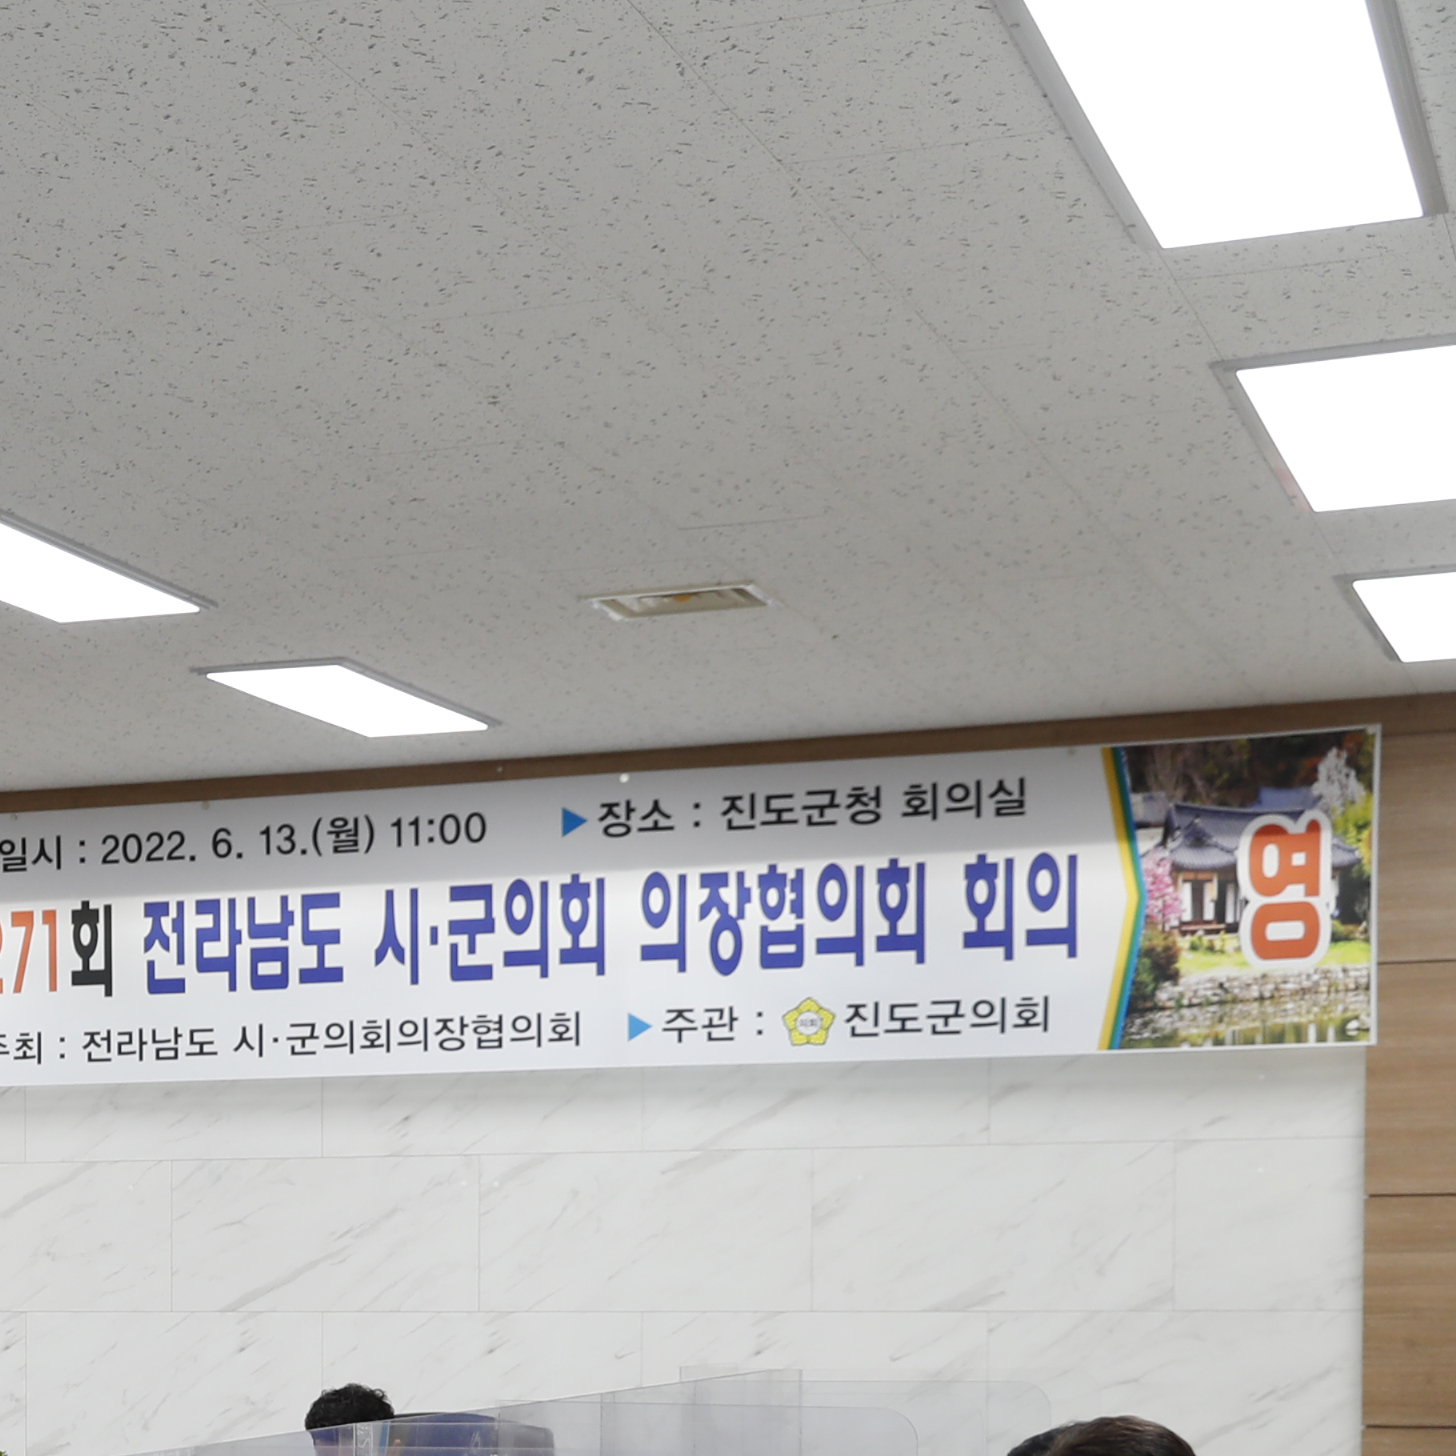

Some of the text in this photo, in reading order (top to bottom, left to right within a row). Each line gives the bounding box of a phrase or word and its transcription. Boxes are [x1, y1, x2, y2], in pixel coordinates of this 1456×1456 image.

[598, 798, 675, 838] 장소
[721, 785, 882, 832] 진도군청
[901, 777, 1027, 822] 회의실
[101, 830, 196, 865] 2022.
[212, 827, 243, 859] 6.
[259, 815, 375, 857] 13.(월)
[390, 812, 487, 848] 11:00
[1252, 821, 1320, 958] 영
[143, 892, 344, 995] 전라남도
[374, 873, 606, 986] 시·군의회
[640, 857, 926, 977] 의장협의회
[962, 852, 1078, 961] 회의
[82, 1026, 217, 1063] 전라남도
[233, 1011, 580, 1058] 시·군의회의장협의회
[661, 1005, 739, 1044] 주관
[845, 995, 1049, 1038] 진도군의회
